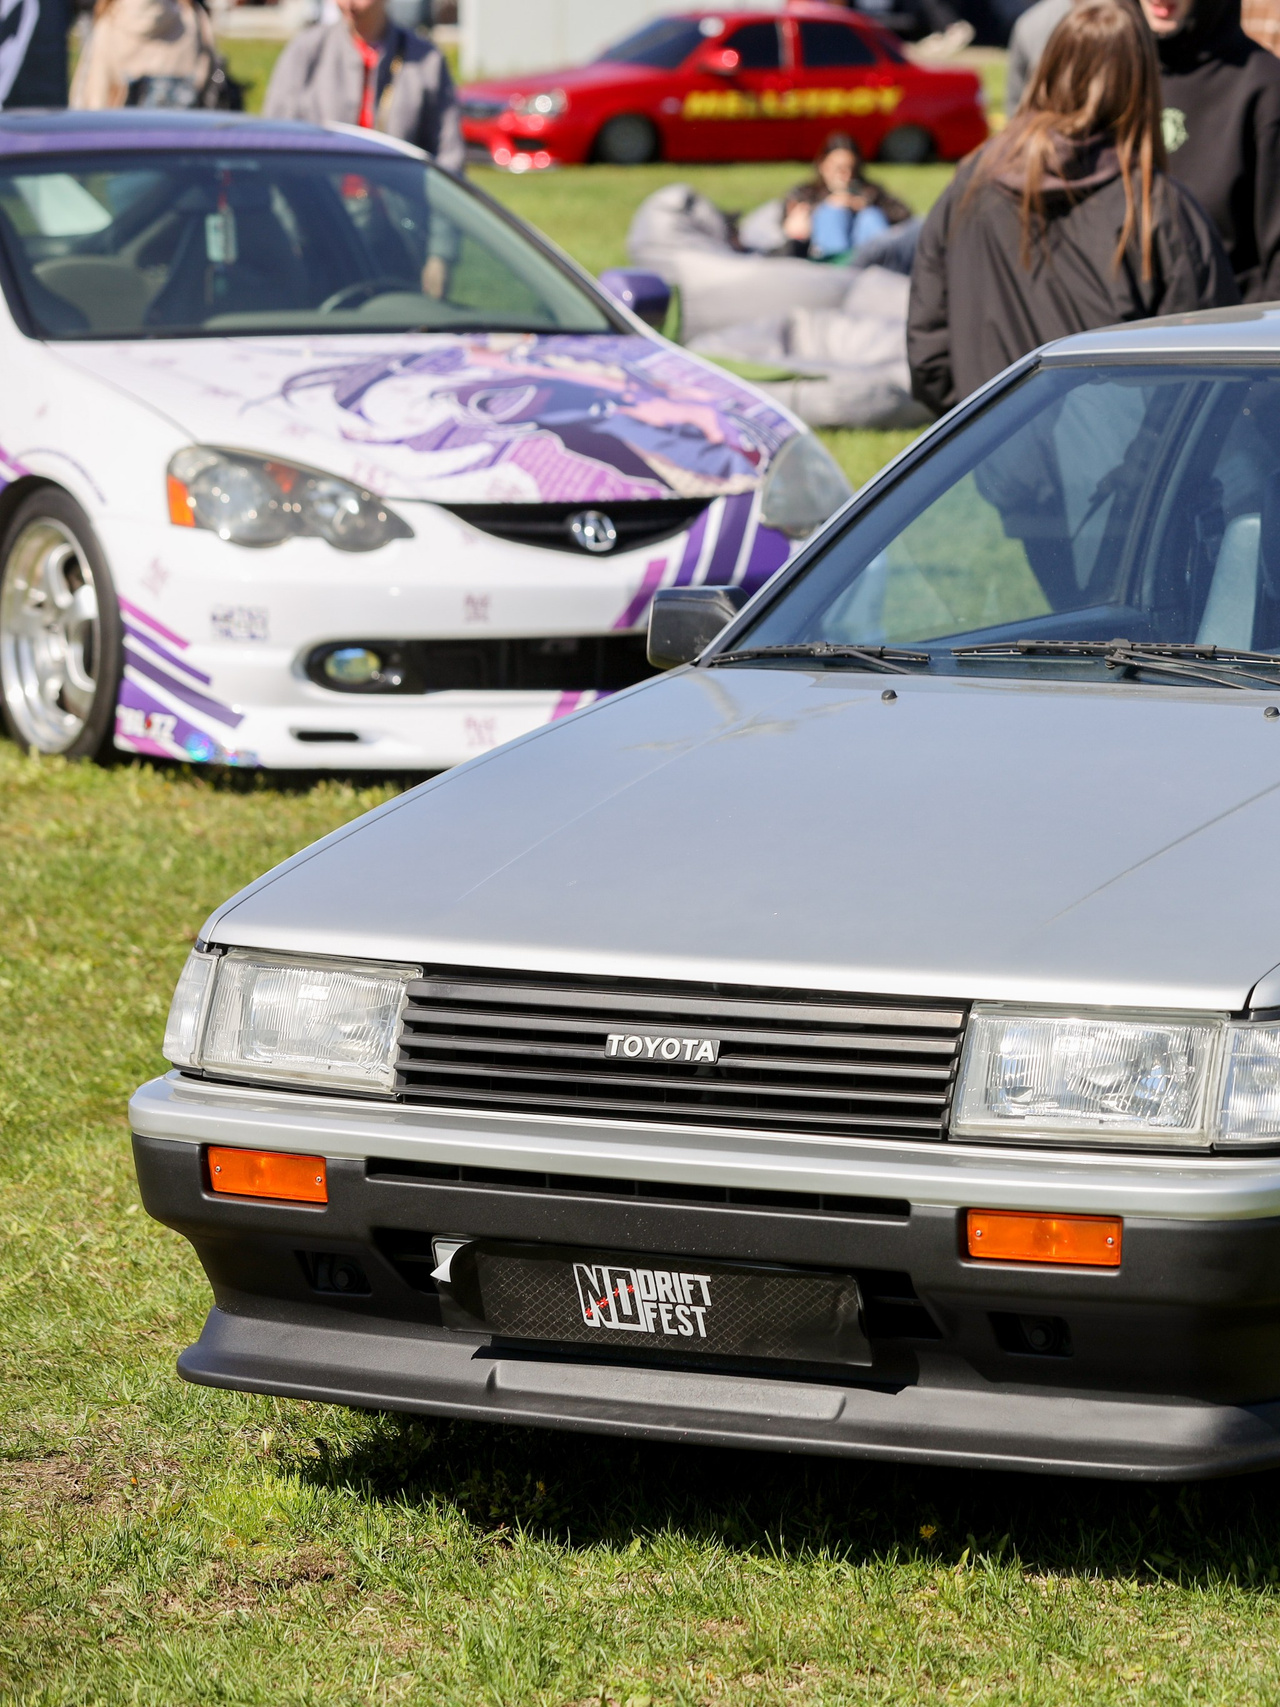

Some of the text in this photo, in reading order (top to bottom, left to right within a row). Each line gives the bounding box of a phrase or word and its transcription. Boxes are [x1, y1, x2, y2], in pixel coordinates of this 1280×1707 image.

[607, 1033, 715, 1062] TOYOTA
[635, 1268, 712, 1307] DRIFT
[642, 1300, 708, 1338] FEST
